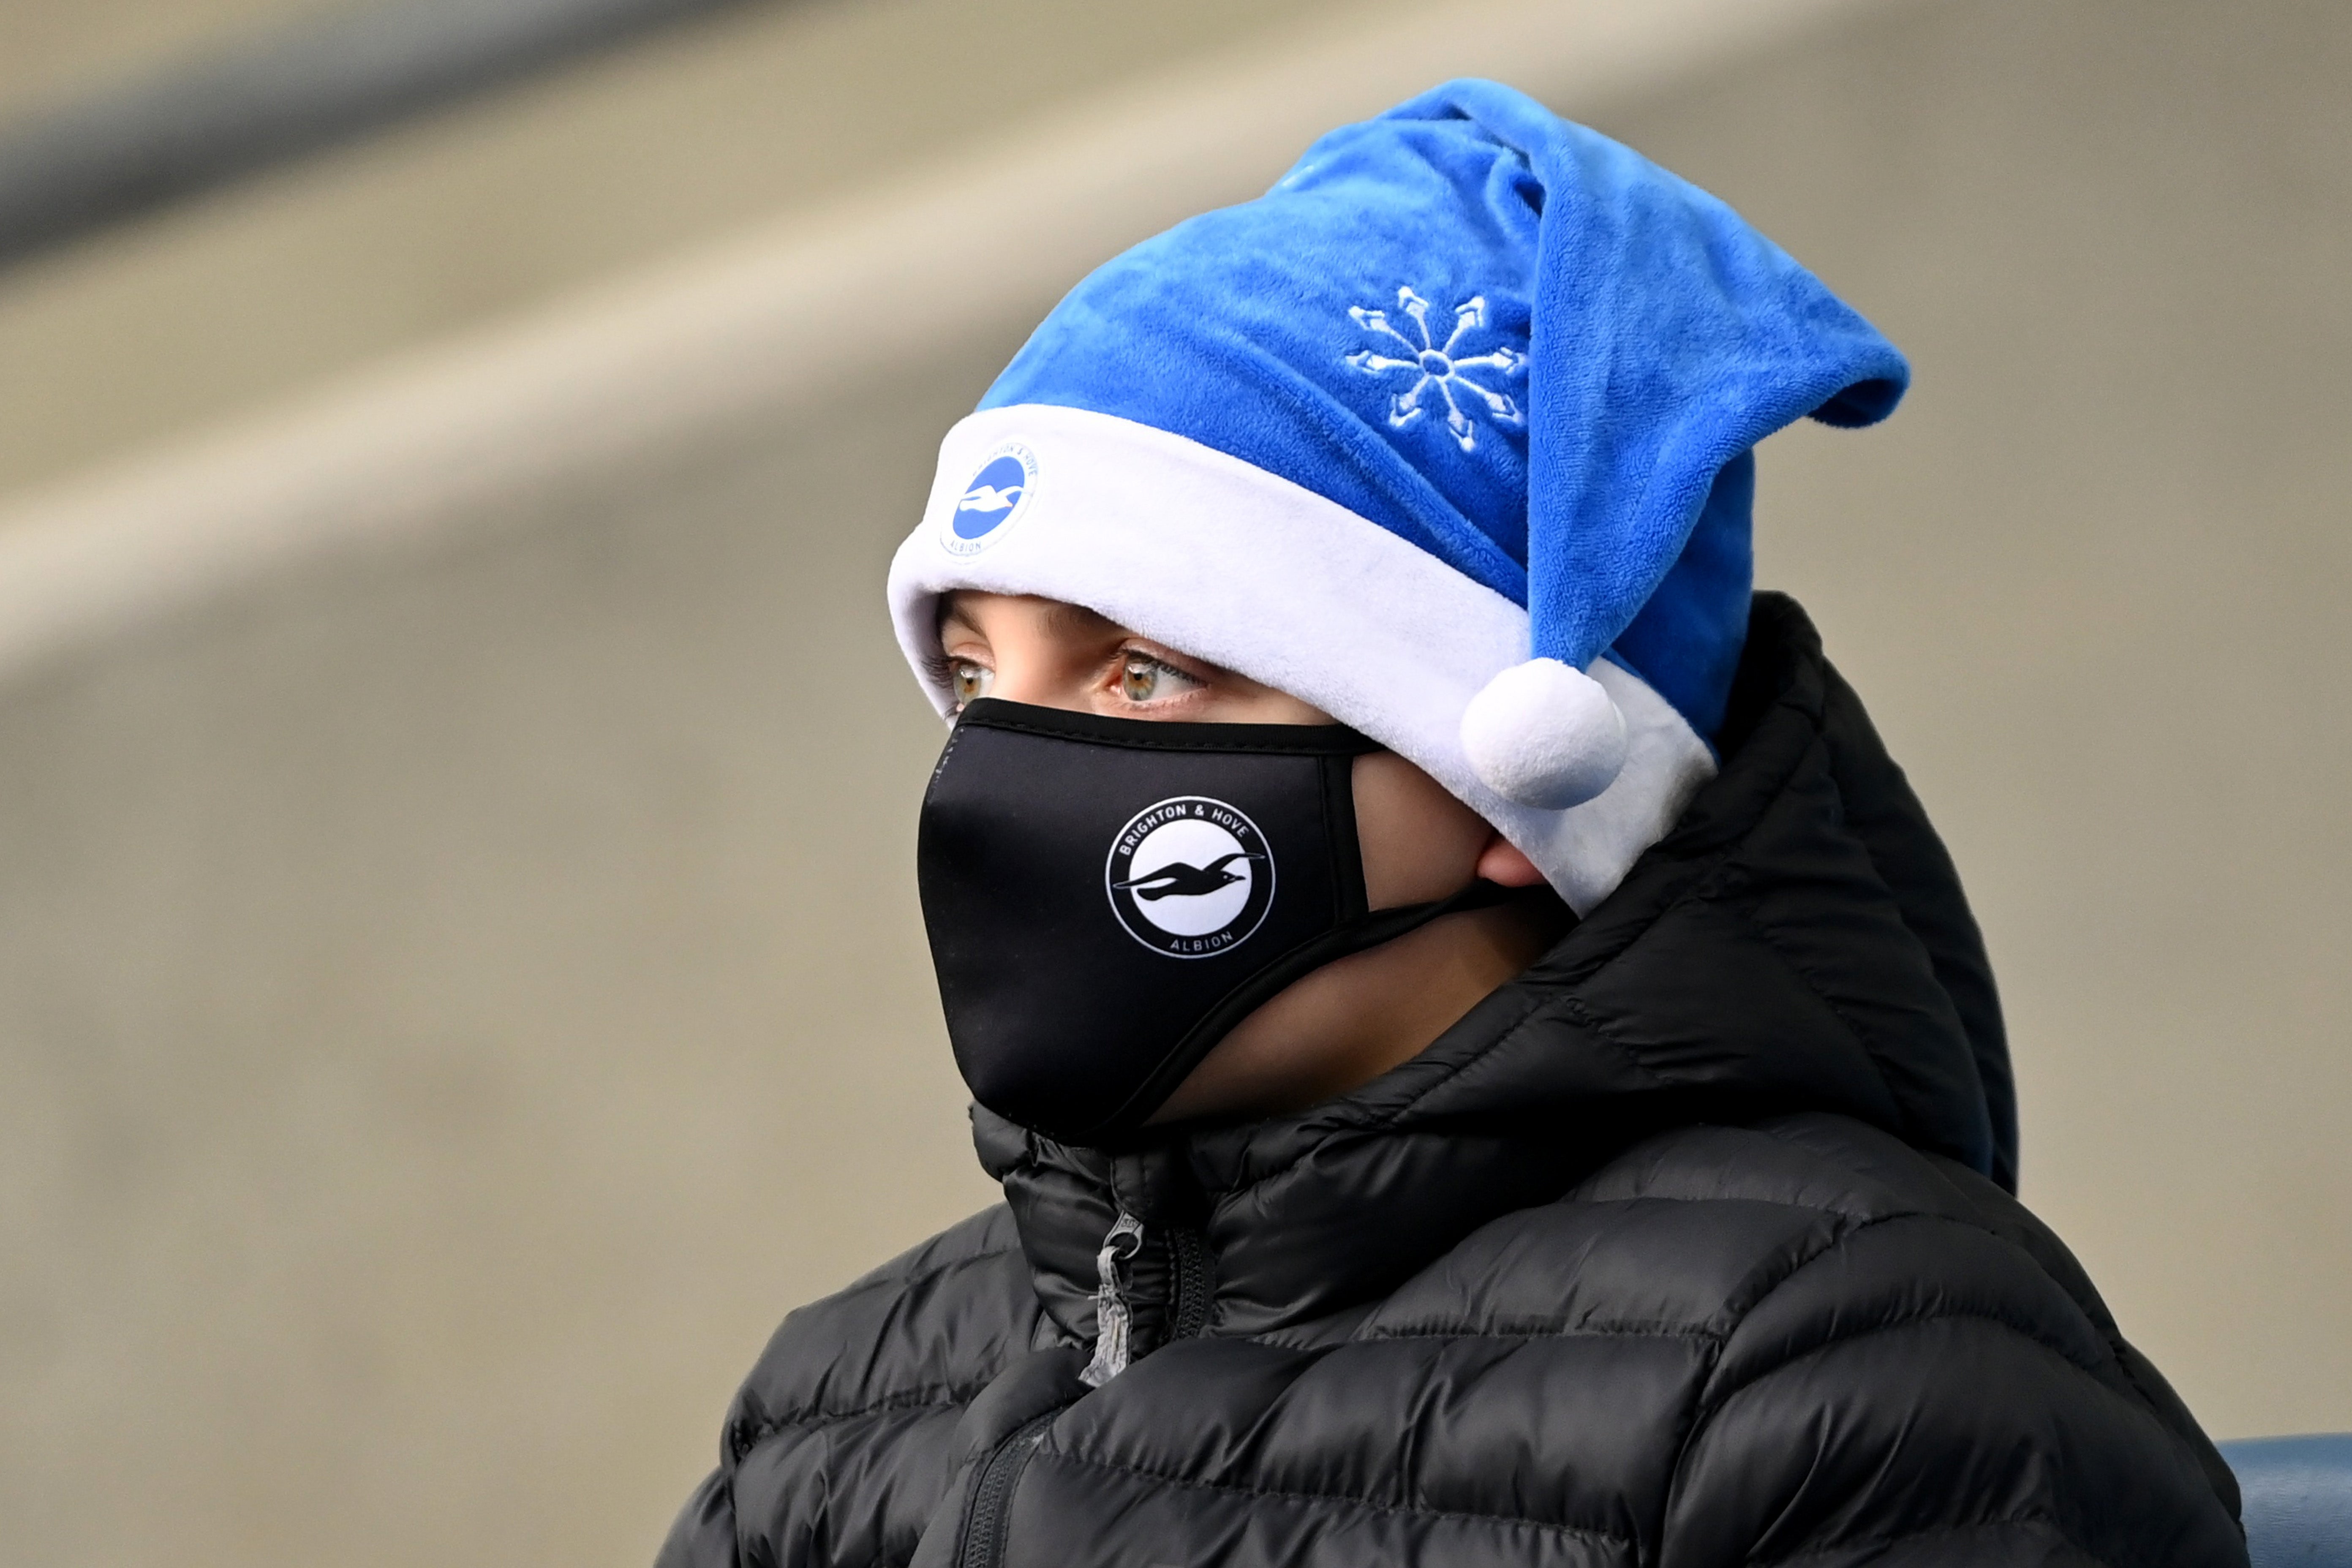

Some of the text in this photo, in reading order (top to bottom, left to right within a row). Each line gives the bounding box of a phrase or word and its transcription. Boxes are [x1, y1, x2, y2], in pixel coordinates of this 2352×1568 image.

[950, 540, 981, 552] ALBION
[1119, 804, 1249, 855] BRIGHTON & HOVE
[1170, 931, 1233, 951] ALBION
